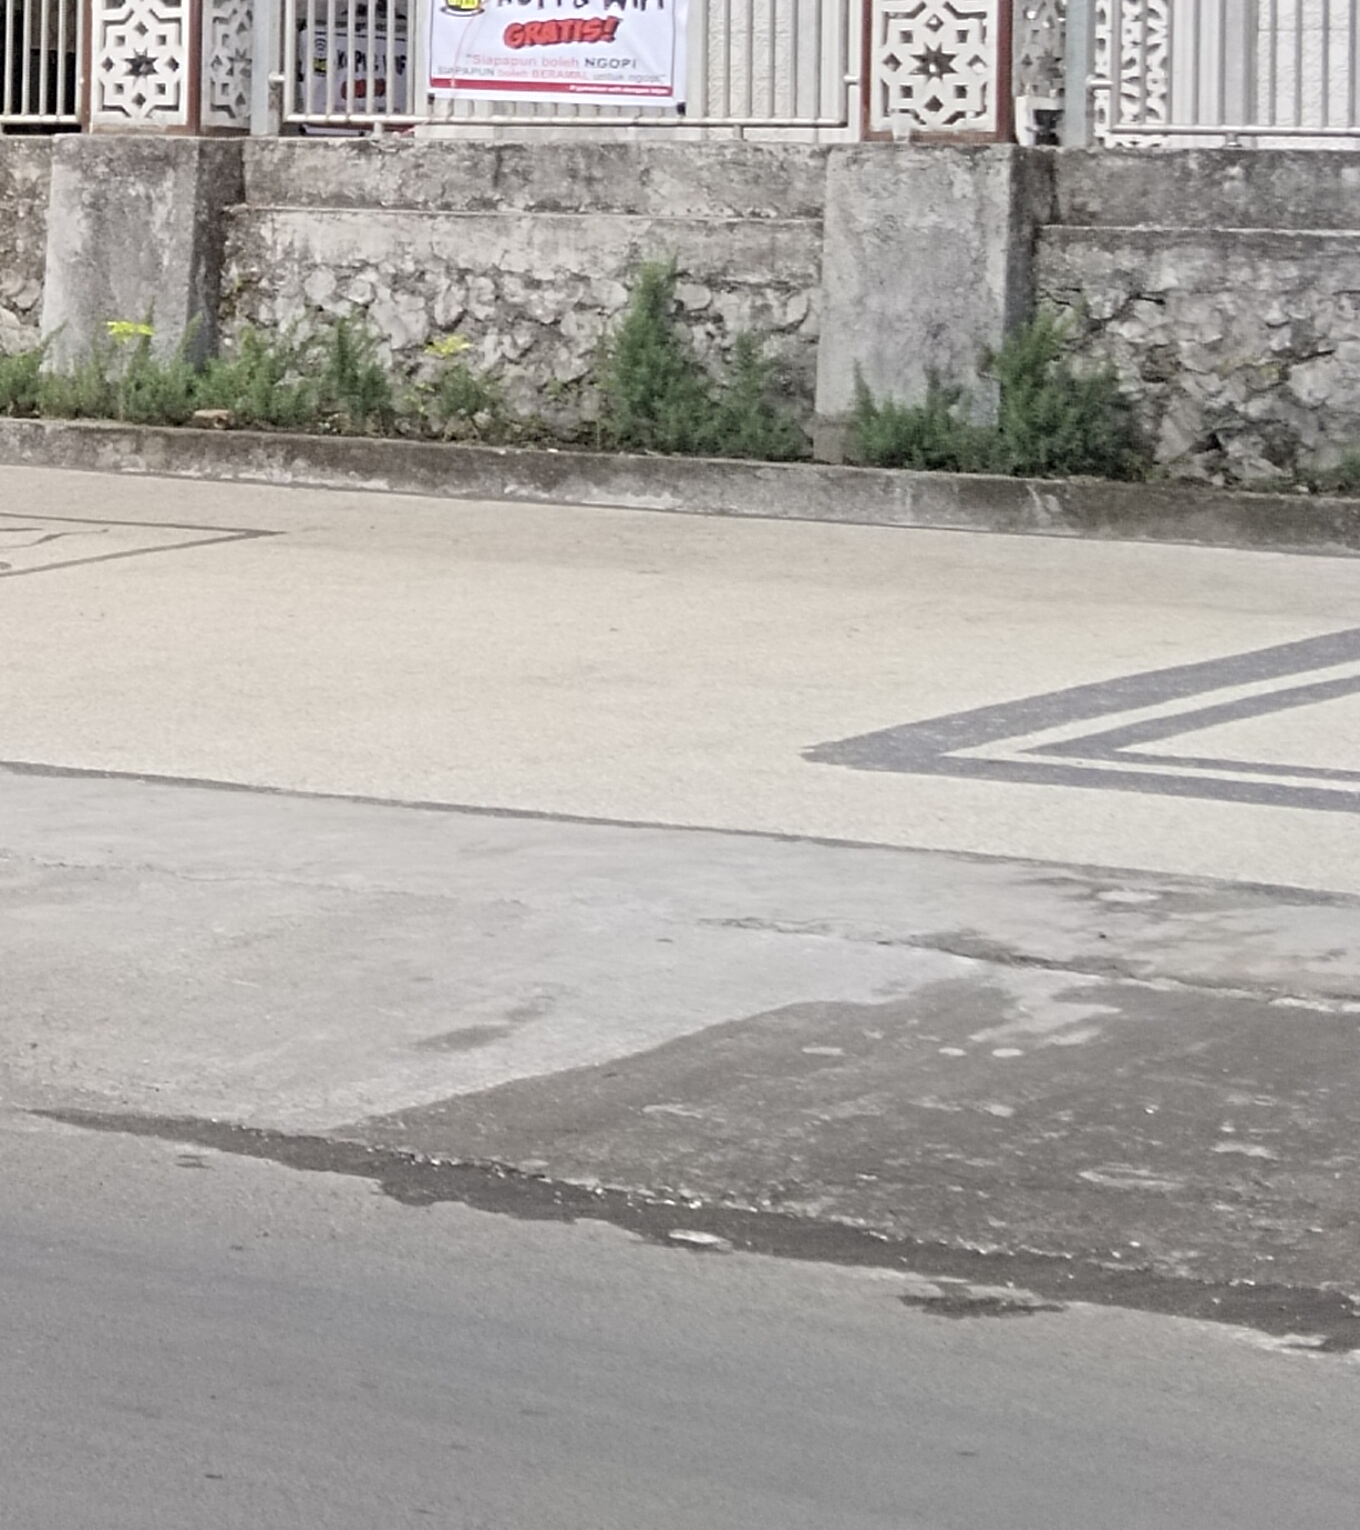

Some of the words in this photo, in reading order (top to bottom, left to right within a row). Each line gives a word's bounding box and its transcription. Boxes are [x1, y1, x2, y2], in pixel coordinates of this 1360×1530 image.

[503, 15, 621, 49] GRATIS!
[542, 56, 579, 67] boleh
[584, 57, 637, 69] NGOPI
